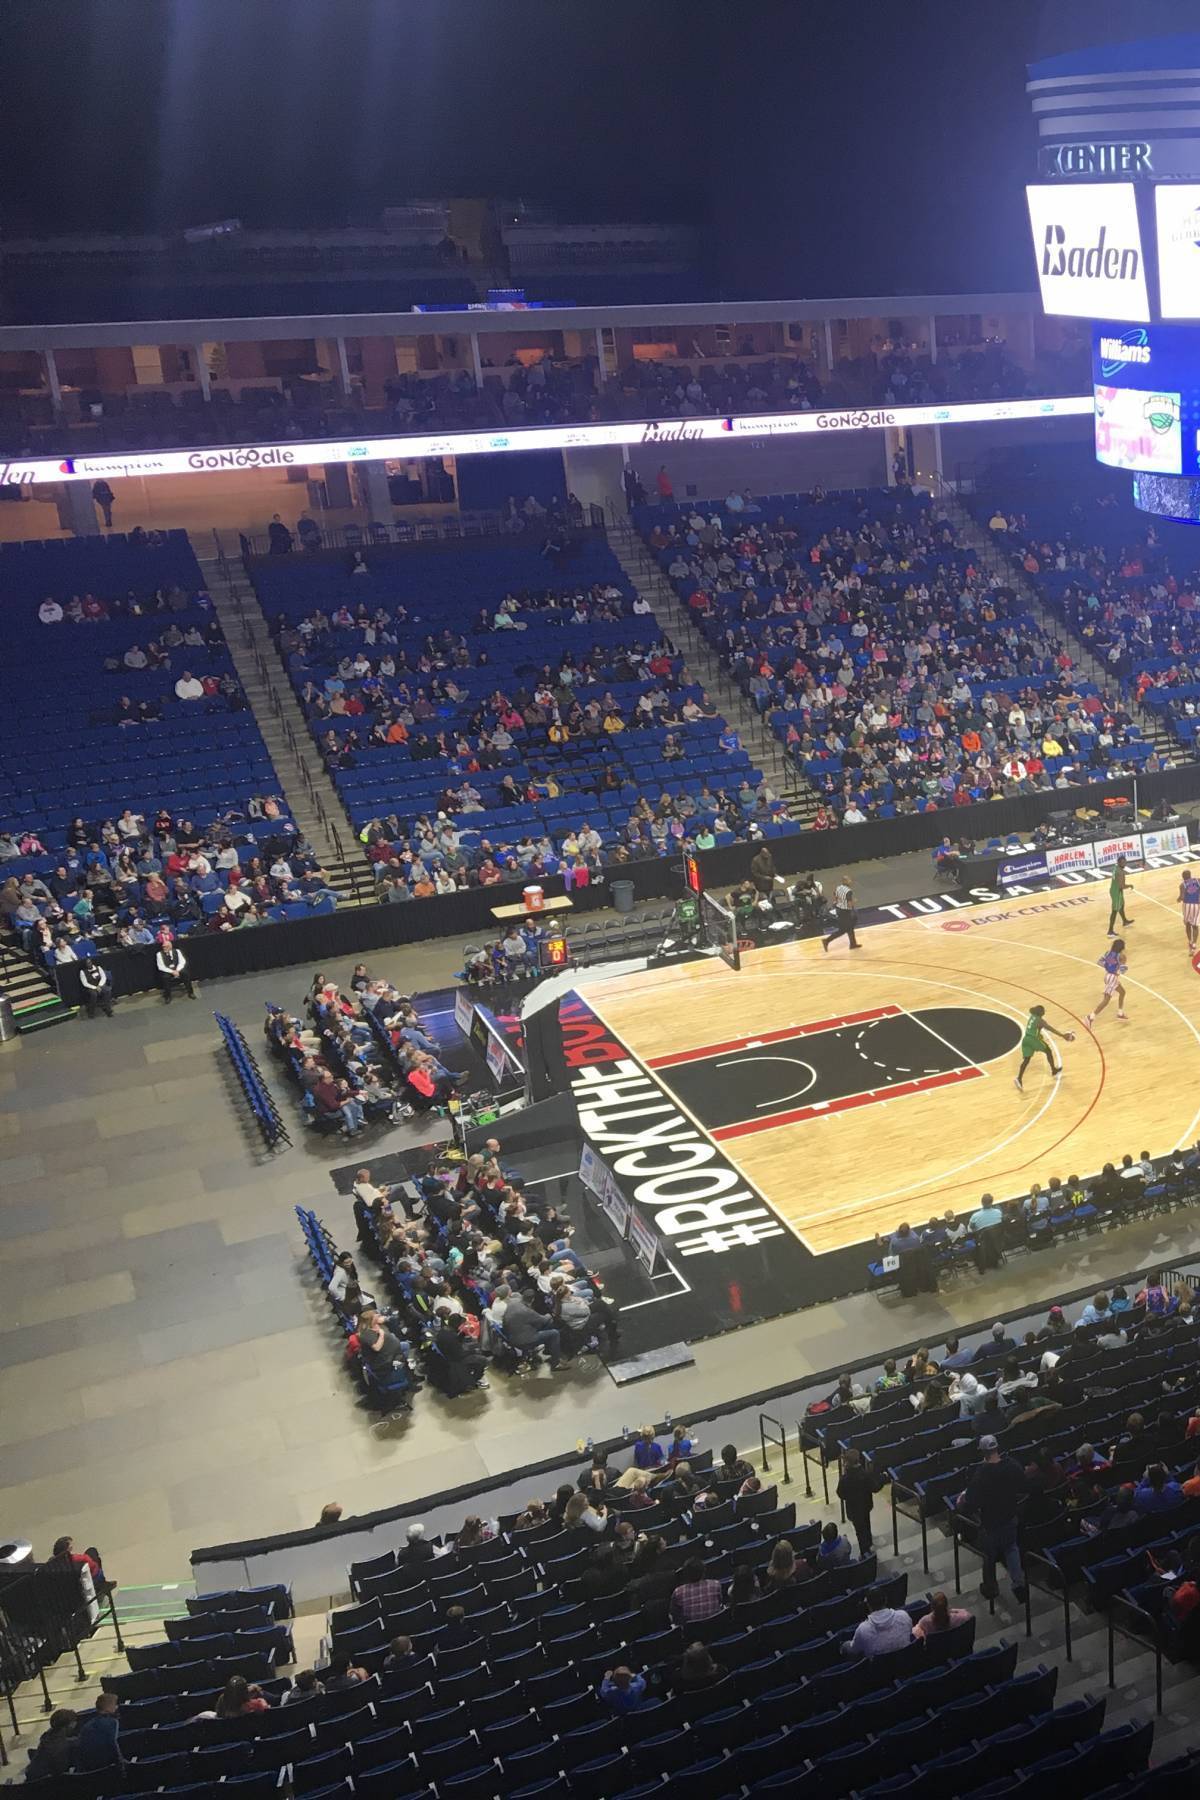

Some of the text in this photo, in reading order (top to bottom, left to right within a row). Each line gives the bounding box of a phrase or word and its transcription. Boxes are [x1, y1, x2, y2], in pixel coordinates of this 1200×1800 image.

[1042, 224, 1139, 281] Baden
[1100, 336, 1152, 364] Williams
[816, 410, 896, 429] GoNoodle
[187, 448, 295, 469] GoNoodle
[1054, 851, 1086, 865] HARLEM
[1102, 842, 1134, 855] HARLEM
[971, 896, 1096, 926] BOK CENTER
[570, 1058, 785, 1256] #ROCKTHE
